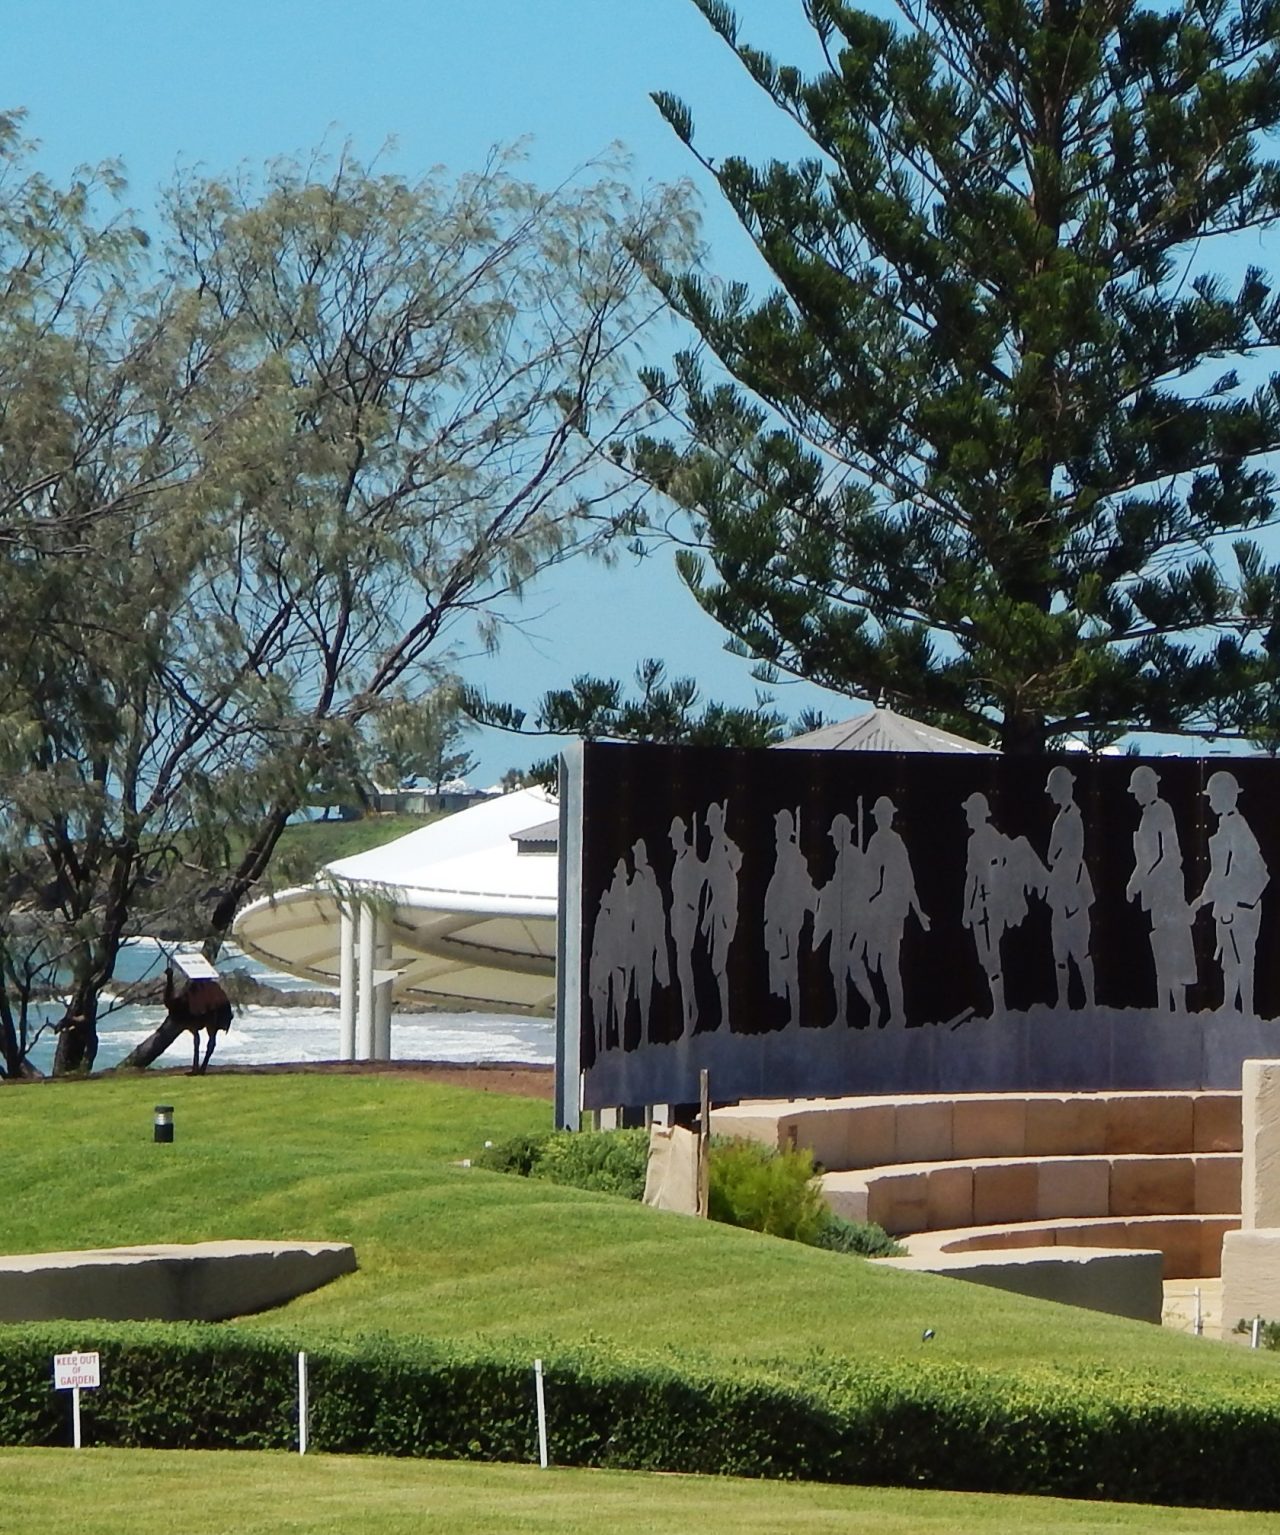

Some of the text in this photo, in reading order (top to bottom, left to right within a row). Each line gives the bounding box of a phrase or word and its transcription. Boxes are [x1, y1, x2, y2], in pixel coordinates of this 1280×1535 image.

[57, 1355, 97, 1366] KEEP OUT
[72, 1366, 81, 1374] OF
[60, 1375, 95, 1386] GARDEN
